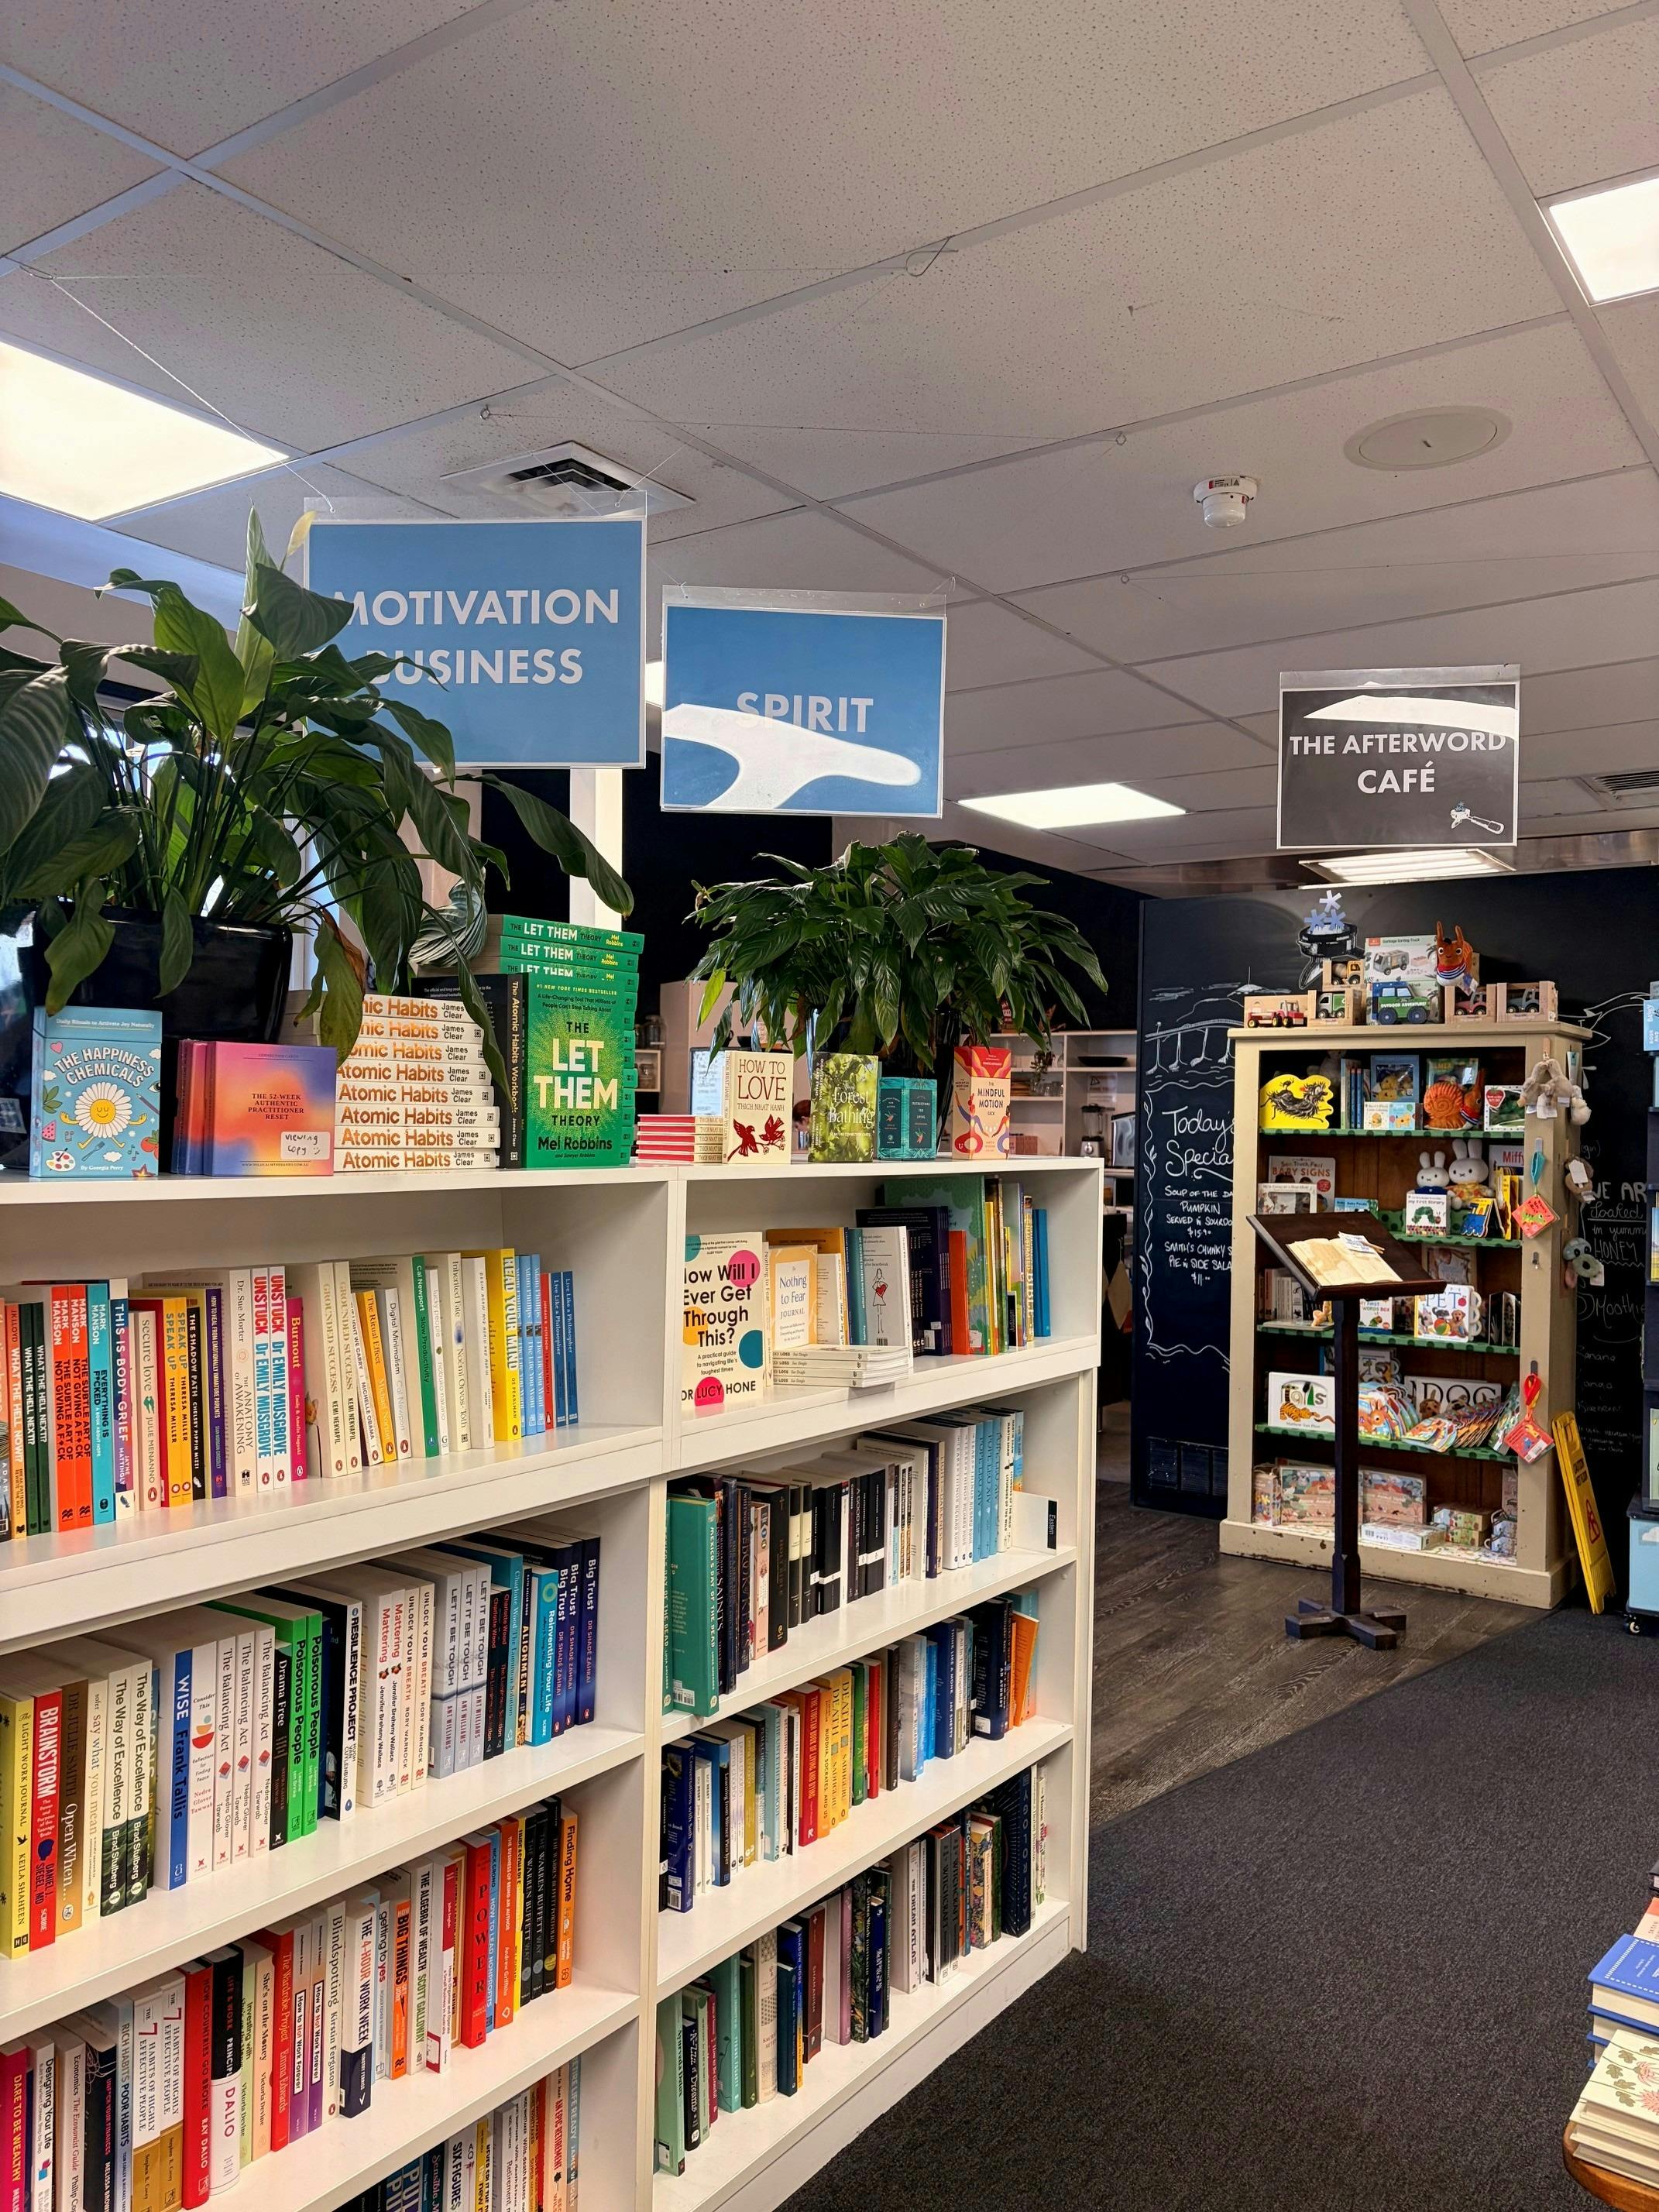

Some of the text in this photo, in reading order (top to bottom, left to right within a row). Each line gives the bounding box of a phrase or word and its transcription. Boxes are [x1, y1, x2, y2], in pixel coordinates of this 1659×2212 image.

[334, 589, 619, 626] MOTIVATION
[737, 692, 874, 733] SPIRIT
[1290, 732, 1506, 755] THE AFTERWORD
[1357, 760, 1435, 794] CAFÉ
[524, 922, 544, 936] LET
[547, 926, 578, 941] THEM
[580, 933, 602, 943] THEORY
[606, 939, 623, 947] Robbins
[566, 1021, 589, 1034] THE
[53, 1047, 155, 1078] THE HAPPINESS
[552, 1038, 604, 1073] LET
[739, 1059, 785, 1074] HOW TO
[65, 1063, 144, 1088] CHEMICALS
[533, 1075, 618, 1110] THEM
[737, 1075, 787, 1101] LOVE
[834, 1086, 870, 1104] Forest
[977, 1088, 1005, 1097] MINDFUL
[455, 1109, 478, 1118] James
[754, 1103, 769, 1111] NHAT
[978, 1099, 1004, 1108] MOTION
[341, 1106, 452, 1125] Atomic Habits
[551, 1115, 600, 1126] THEORY
[828, 1103, 875, 1129] Bathing
[284, 1134, 319, 1146] viewing
[287, 1146, 307, 1156] copy
[538, 1136, 613, 1151] Mel Robbins
[342, 1151, 451, 1169] Atomic Habits
[1166, 1139, 1234, 1176] Specia
[1503, 1151, 1524, 1167] Miffy
[1272, 1167, 1331, 1177] BABY SIGNS
[1621, 1181, 1647, 1202] AR
[1180, 1200, 1221, 1214] PUMPKIN
[1166, 1214, 1194, 1224] SERVED
[1609, 1224, 1647, 1242] yumm
[1594, 1238, 1637, 1262] HONEY
[717, 1263, 745, 1281] Will
[750, 1263, 755, 1279] I
[1169, 1254, 1232, 1271] PIE SIDE SALA
[779, 1276, 807, 1289] Nothing
[417, 1279, 425, 1311] Newport
[684, 1284, 751, 1305] Ever Get
[781, 1292, 805, 1304] to Fear
[70, 1299, 81, 1344] MANSON
[78, 1298, 87, 1328] MARK
[503, 1257, 518, 1369] READ YOUR MIND
[684, 1306, 748, 1328] Through
[780, 1307, 805, 1319] JOURNAL
[166, 1313, 177, 1370] SPEAK UP
[291, 1317, 301, 1369] Burnout
[389, 1303, 400, 1375] Digital Minimalism
[698, 1327, 735, 1347] This?
[254, 1276, 271, 1458] UNSTUCK Dr EMILY MUSGROVE
[702, 1351, 723, 1360] practical
[702, 1358, 726, 1369] navigating
[115, 1304, 129, 1442] THIS IS BODY GRIEF
[700, 1366, 720, 1375] toughest
[682, 1381, 756, 1401] DR LUCY HONE
[586, 1558, 596, 1610] Big Trust
[391, 1603, 404, 1658] Mattering
[258, 1638, 273, 1741] The Balancing Act
[347, 1616, 359, 1741] RESILIENCE PROJECT
[307, 1635, 322, 1760] Poisonous People
[37, 1706, 59, 1799] BRAINSTORM
[173, 1674, 190, 1819] WISE Frank Tallis
[61, 1803, 77, 1839] Open
[564, 1825, 575, 1902] Finding Home
[395, 1915, 410, 1984] BIG THINGS
[475, 1884, 488, 1995] POWER
[358, 1916, 373, 2045] THE 4-HOUR WORK WEEK
[224, 2087, 235, 2138] DALIO
